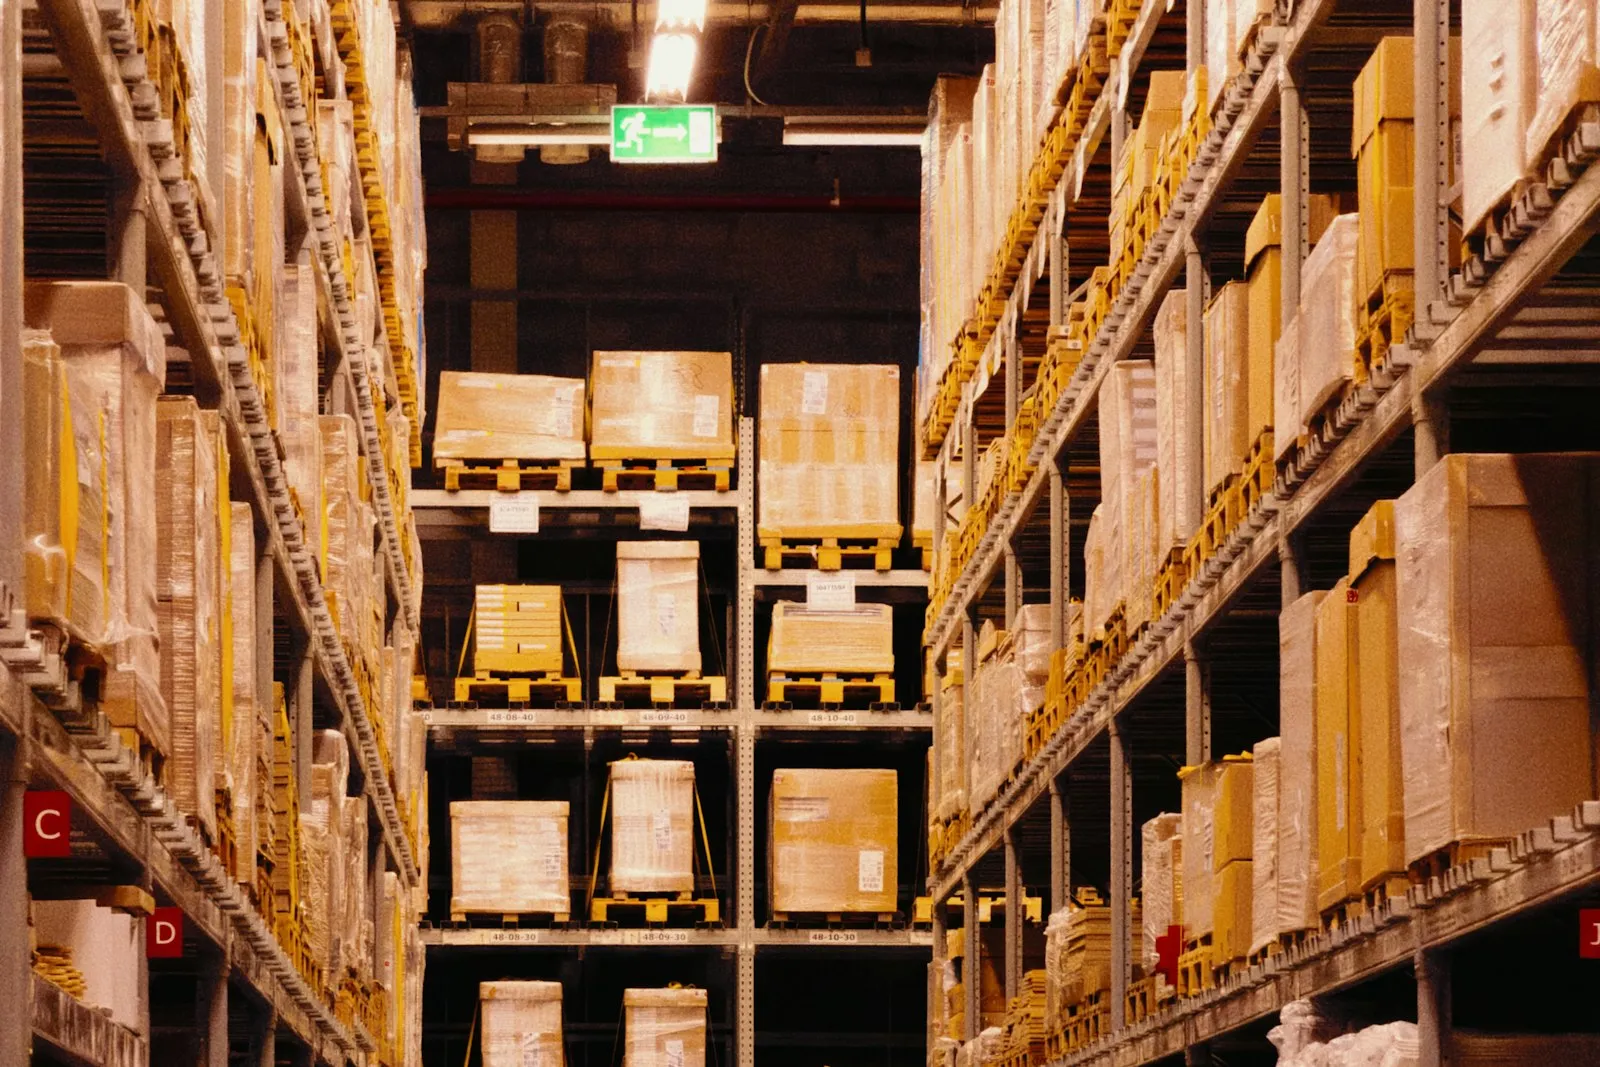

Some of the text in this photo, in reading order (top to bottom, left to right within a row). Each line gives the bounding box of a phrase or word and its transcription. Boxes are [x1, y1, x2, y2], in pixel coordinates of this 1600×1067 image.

[490, 713, 534, 721] 48-08-40
[35, 809, 61, 839] C
[156, 921, 176, 944] D
[493, 933, 536, 941] 48-08-30
[643, 933, 686, 941] 48-09-30
[812, 933, 855, 941] 48-10-30
